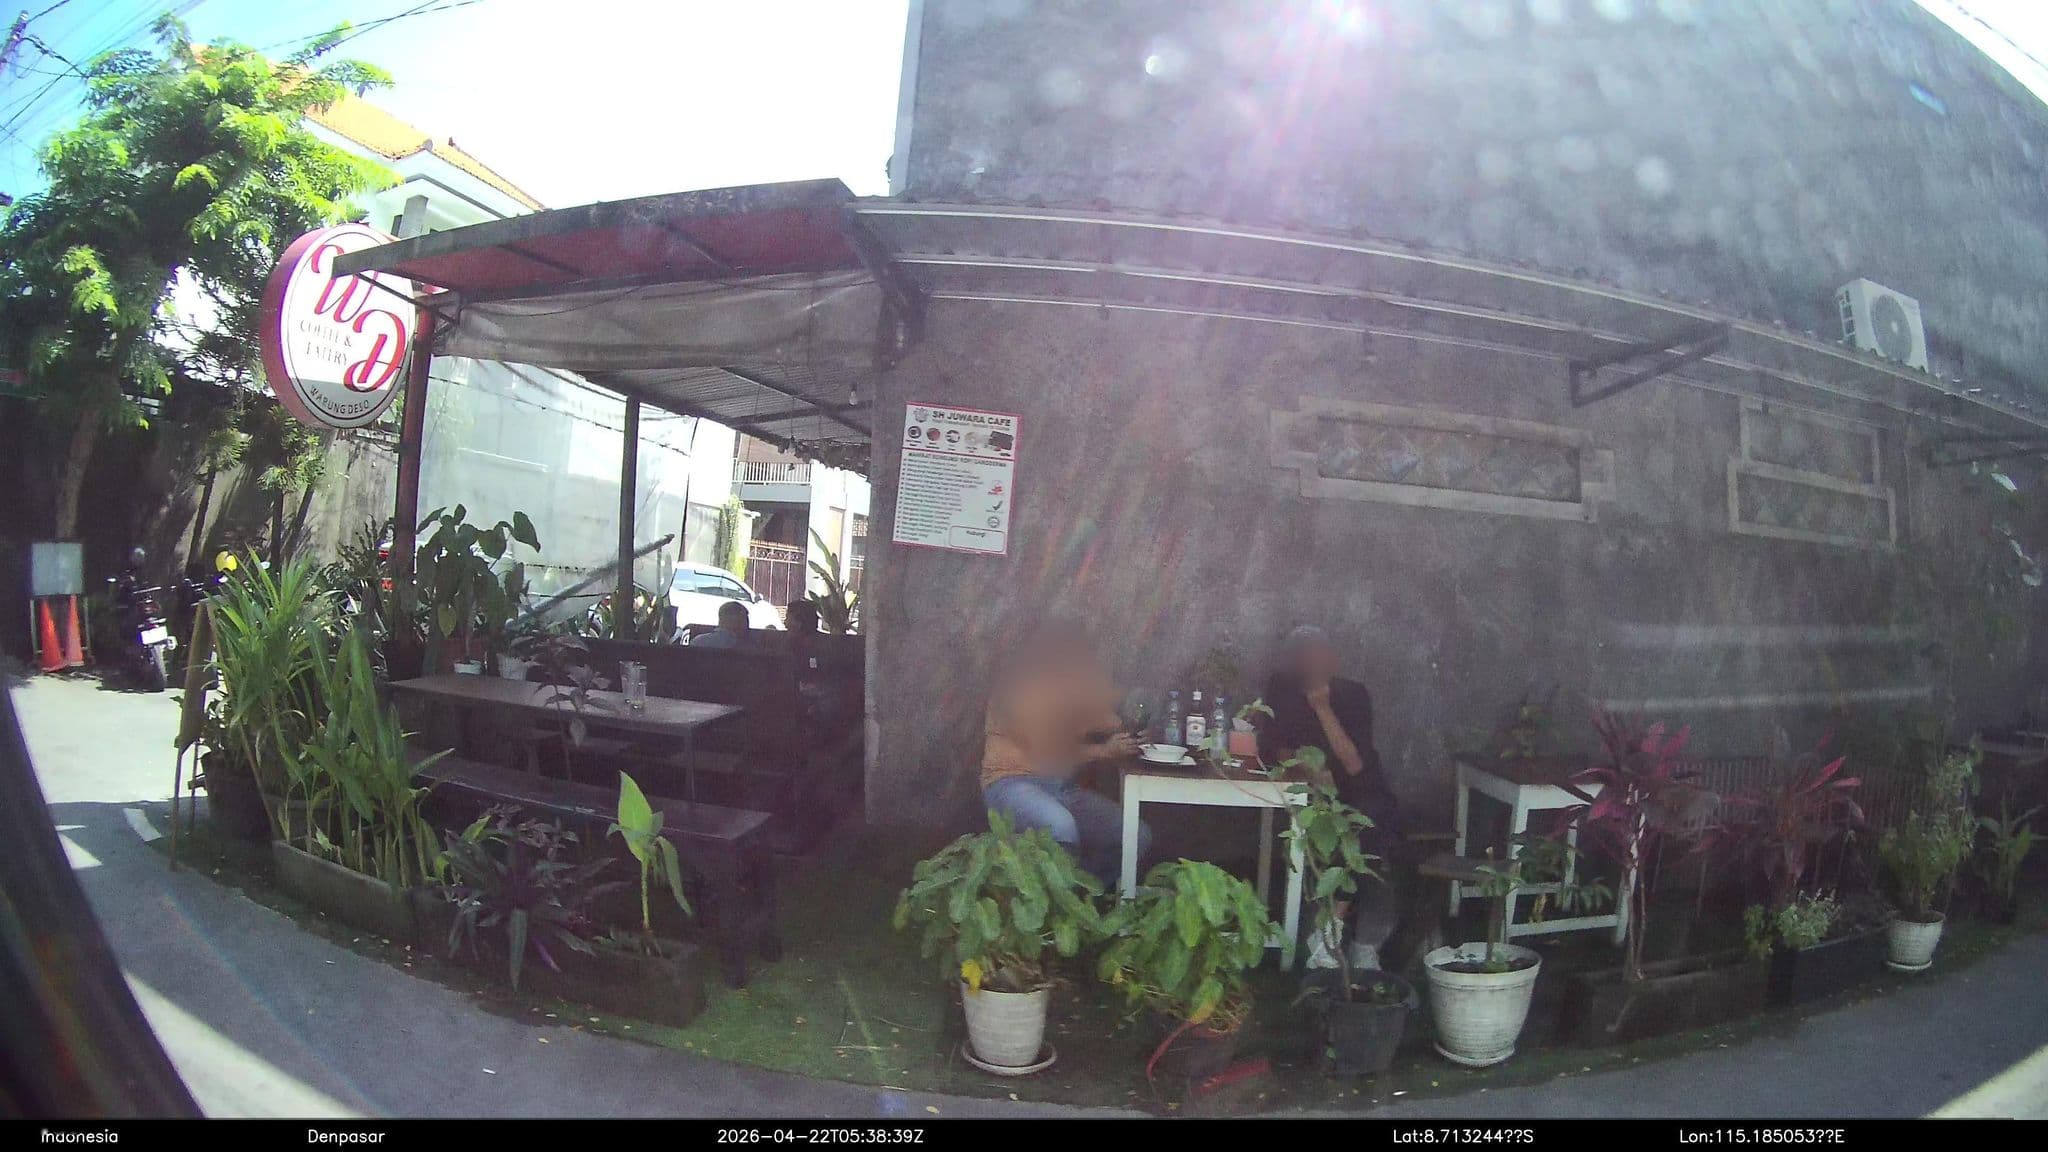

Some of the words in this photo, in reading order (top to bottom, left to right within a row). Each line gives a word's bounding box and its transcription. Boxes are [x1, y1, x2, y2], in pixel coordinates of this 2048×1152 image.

[344, 335, 352, 348] &
[306, 341, 347, 366] EATERY
[311, 386, 346, 414] WARUNG
[348, 400, 369, 415] DESO
[947, 412, 986, 424] JUWARA
[987, 417, 1012, 427] CAFE
